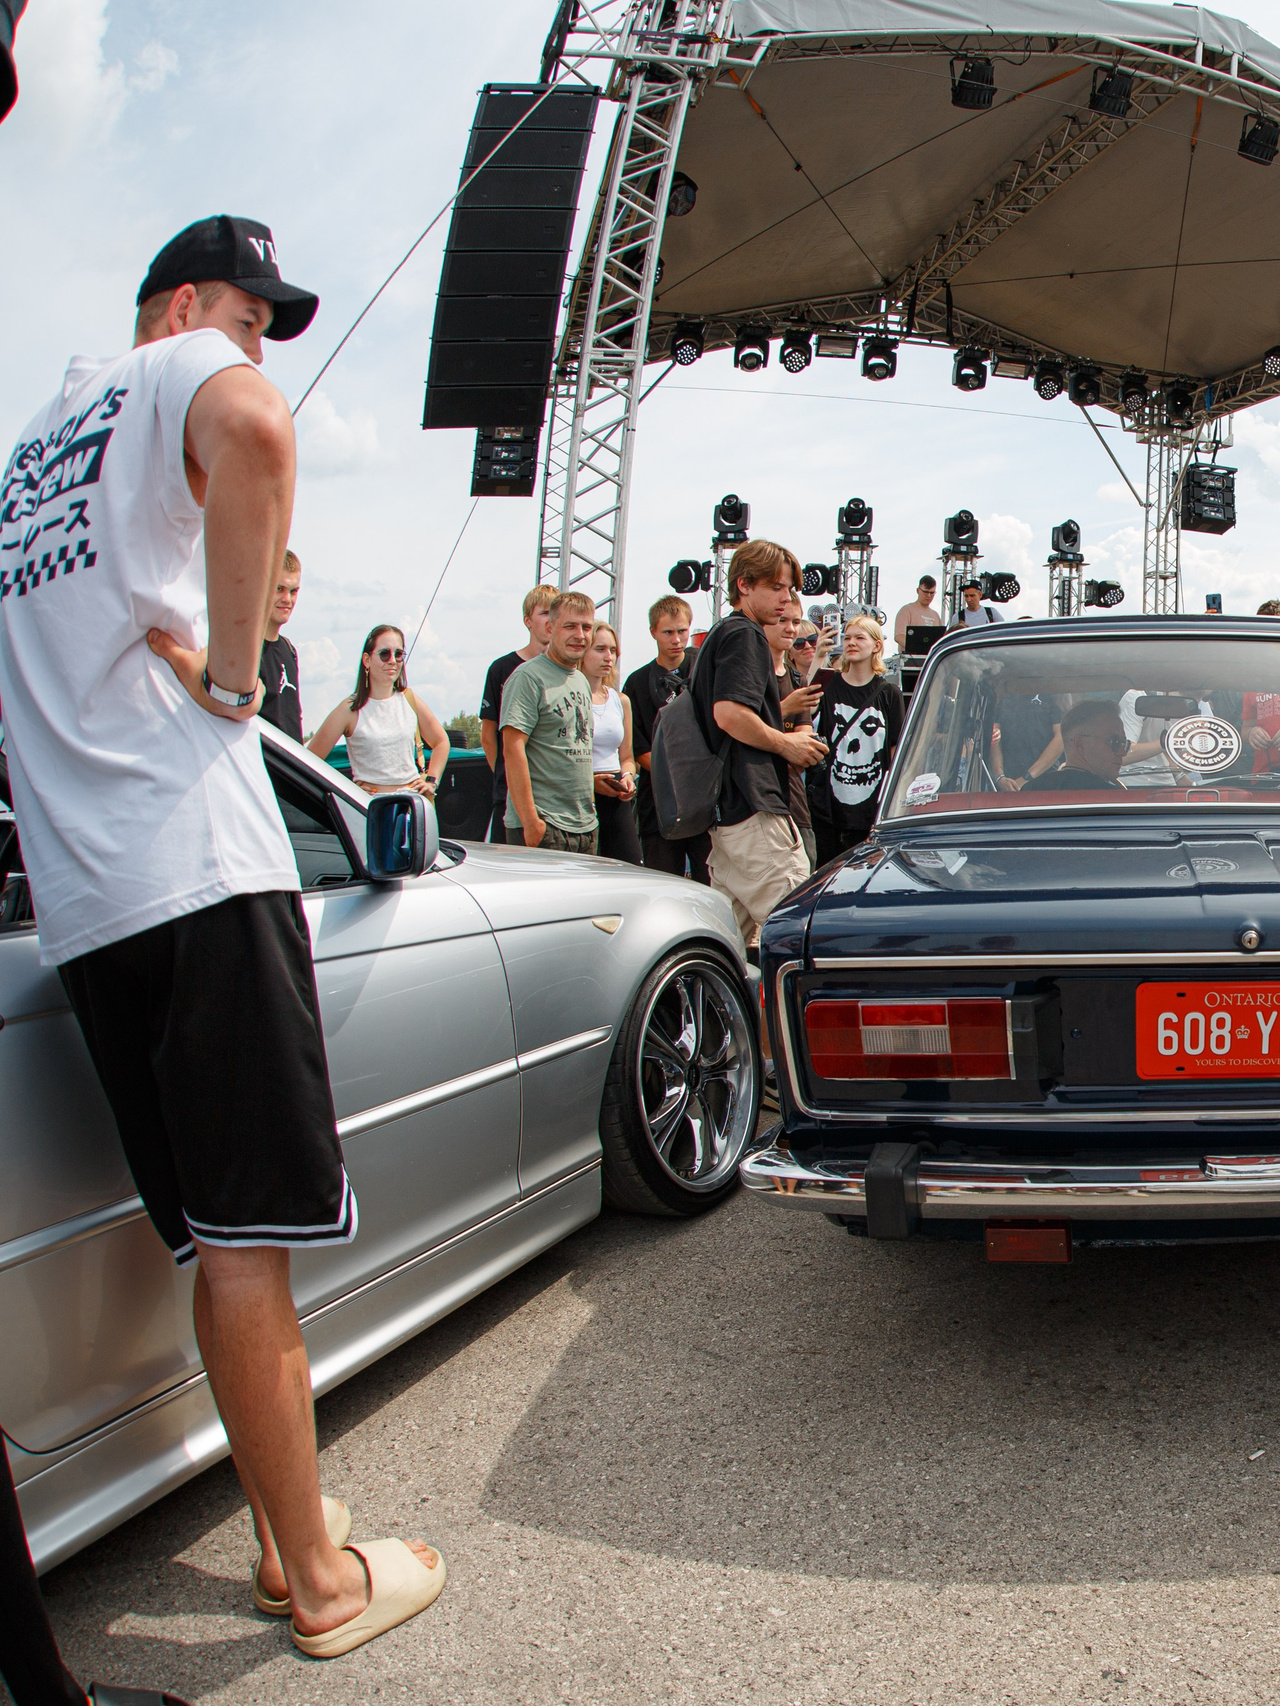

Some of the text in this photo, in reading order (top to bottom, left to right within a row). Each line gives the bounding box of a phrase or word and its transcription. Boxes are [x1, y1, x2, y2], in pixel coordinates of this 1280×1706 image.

[1177, 722, 1229, 737] PERM AUTO
[1182, 753, 1227, 765] WEEKEND
[1157, 1011, 1232, 1056] 608
[1195, 1059, 1227, 1067] YOURS
[1228, 1058, 1242, 1066] TO
